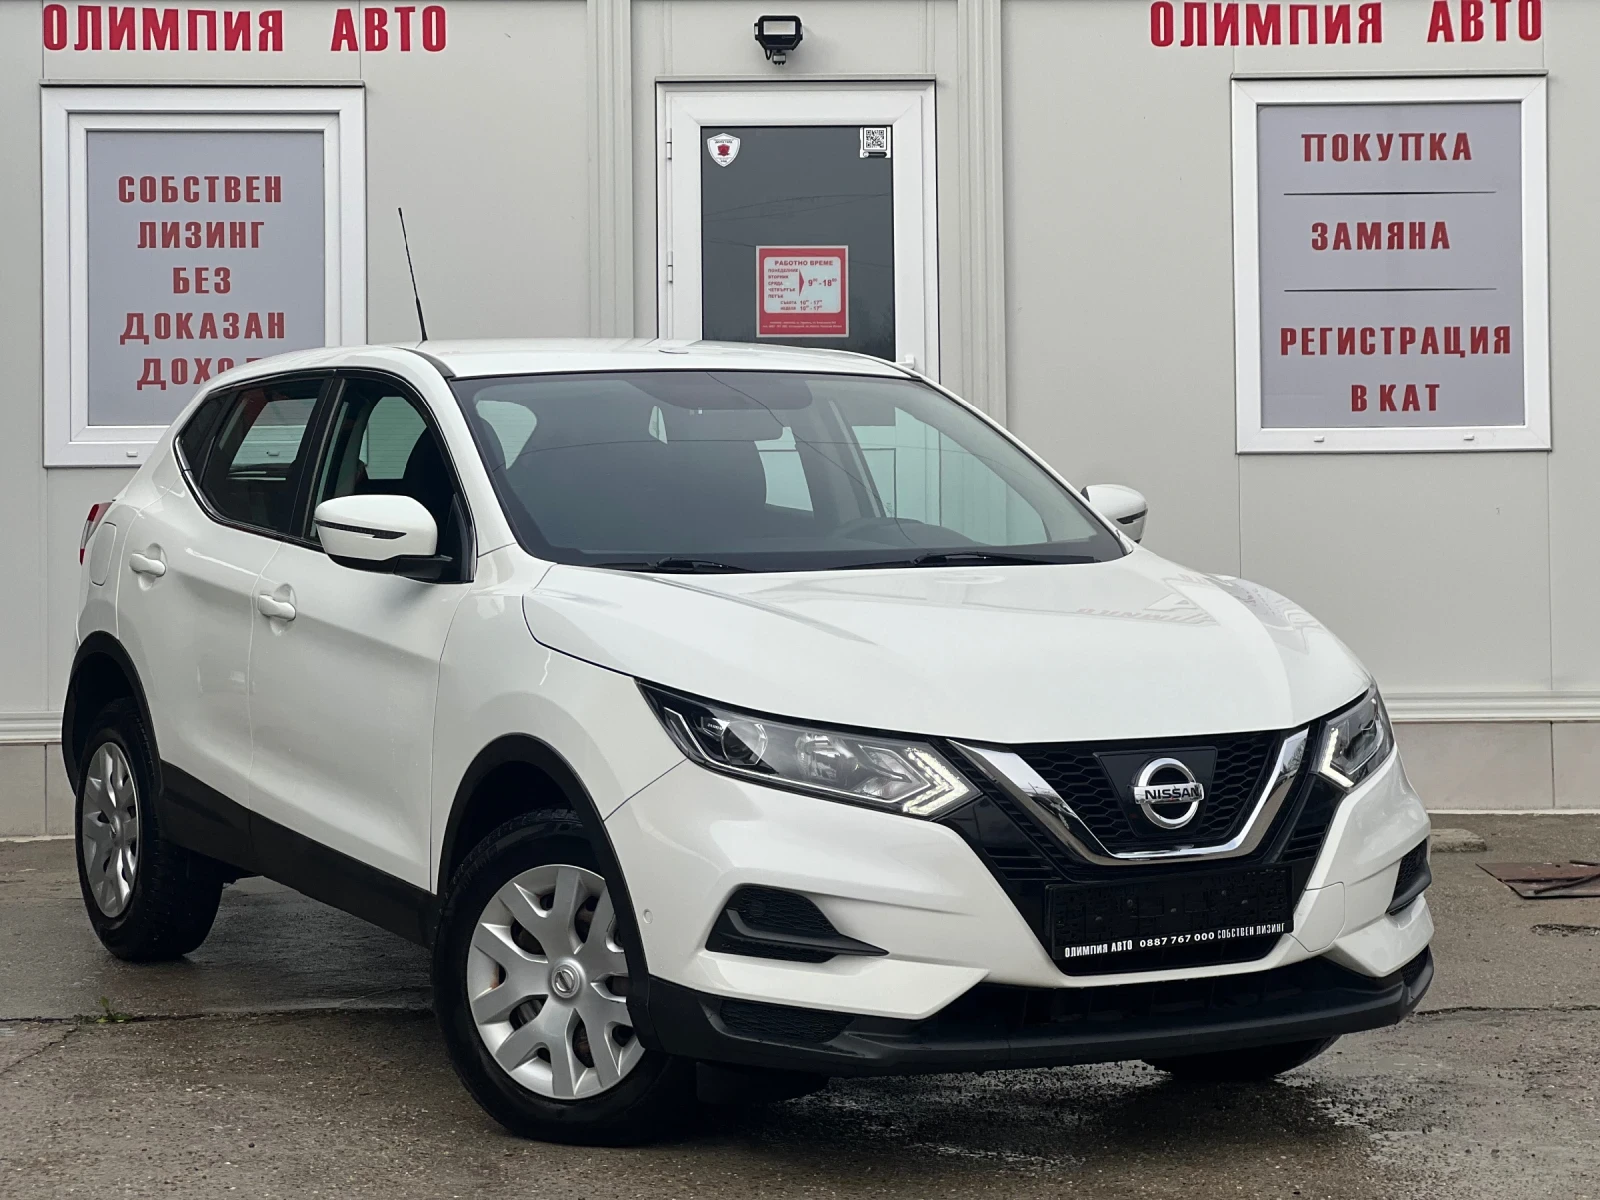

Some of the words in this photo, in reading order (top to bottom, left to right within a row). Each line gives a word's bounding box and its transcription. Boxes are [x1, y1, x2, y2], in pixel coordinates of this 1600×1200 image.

[42, 4, 284, 52] ОЛИМПИЯ
[330, 5, 448, 53] АВТО
[1149, 1, 1384, 48] ОЛИМПИЯ
[1426, 0, 1543, 44] АВТО
[1302, 132, 1473, 162] ПОКУПКА
[118, 176, 282, 203] СОБСТВЕН
[137, 222, 265, 248] ЛИЗИНГ
[1311, 221, 1451, 251] ЗАМЯНА
[173, 267, 231, 294] БЕЗ
[119, 312, 285, 345] ДОКАЗАН
[1280, 326, 1511, 358] РЕГИСТРАЦИЯ
[137, 357, 263, 390] ДОХО
[1351, 384, 1368, 412] В
[1379, 384, 1440, 412] КАТ
[1144, 787, 1200, 800] NISSAN
[1064, 943, 1108, 958] ОЛИМПИЯ
[1111, 939, 1133, 953] АВТО
[1139, 937, 1168, 948] 0887
[1170, 935, 1192, 945] 767
[1194, 931, 1215, 942] 000
[1217, 926, 1254, 939] СОБСТВЕН
[1256, 922, 1285, 935] ЛИЗИНГ
